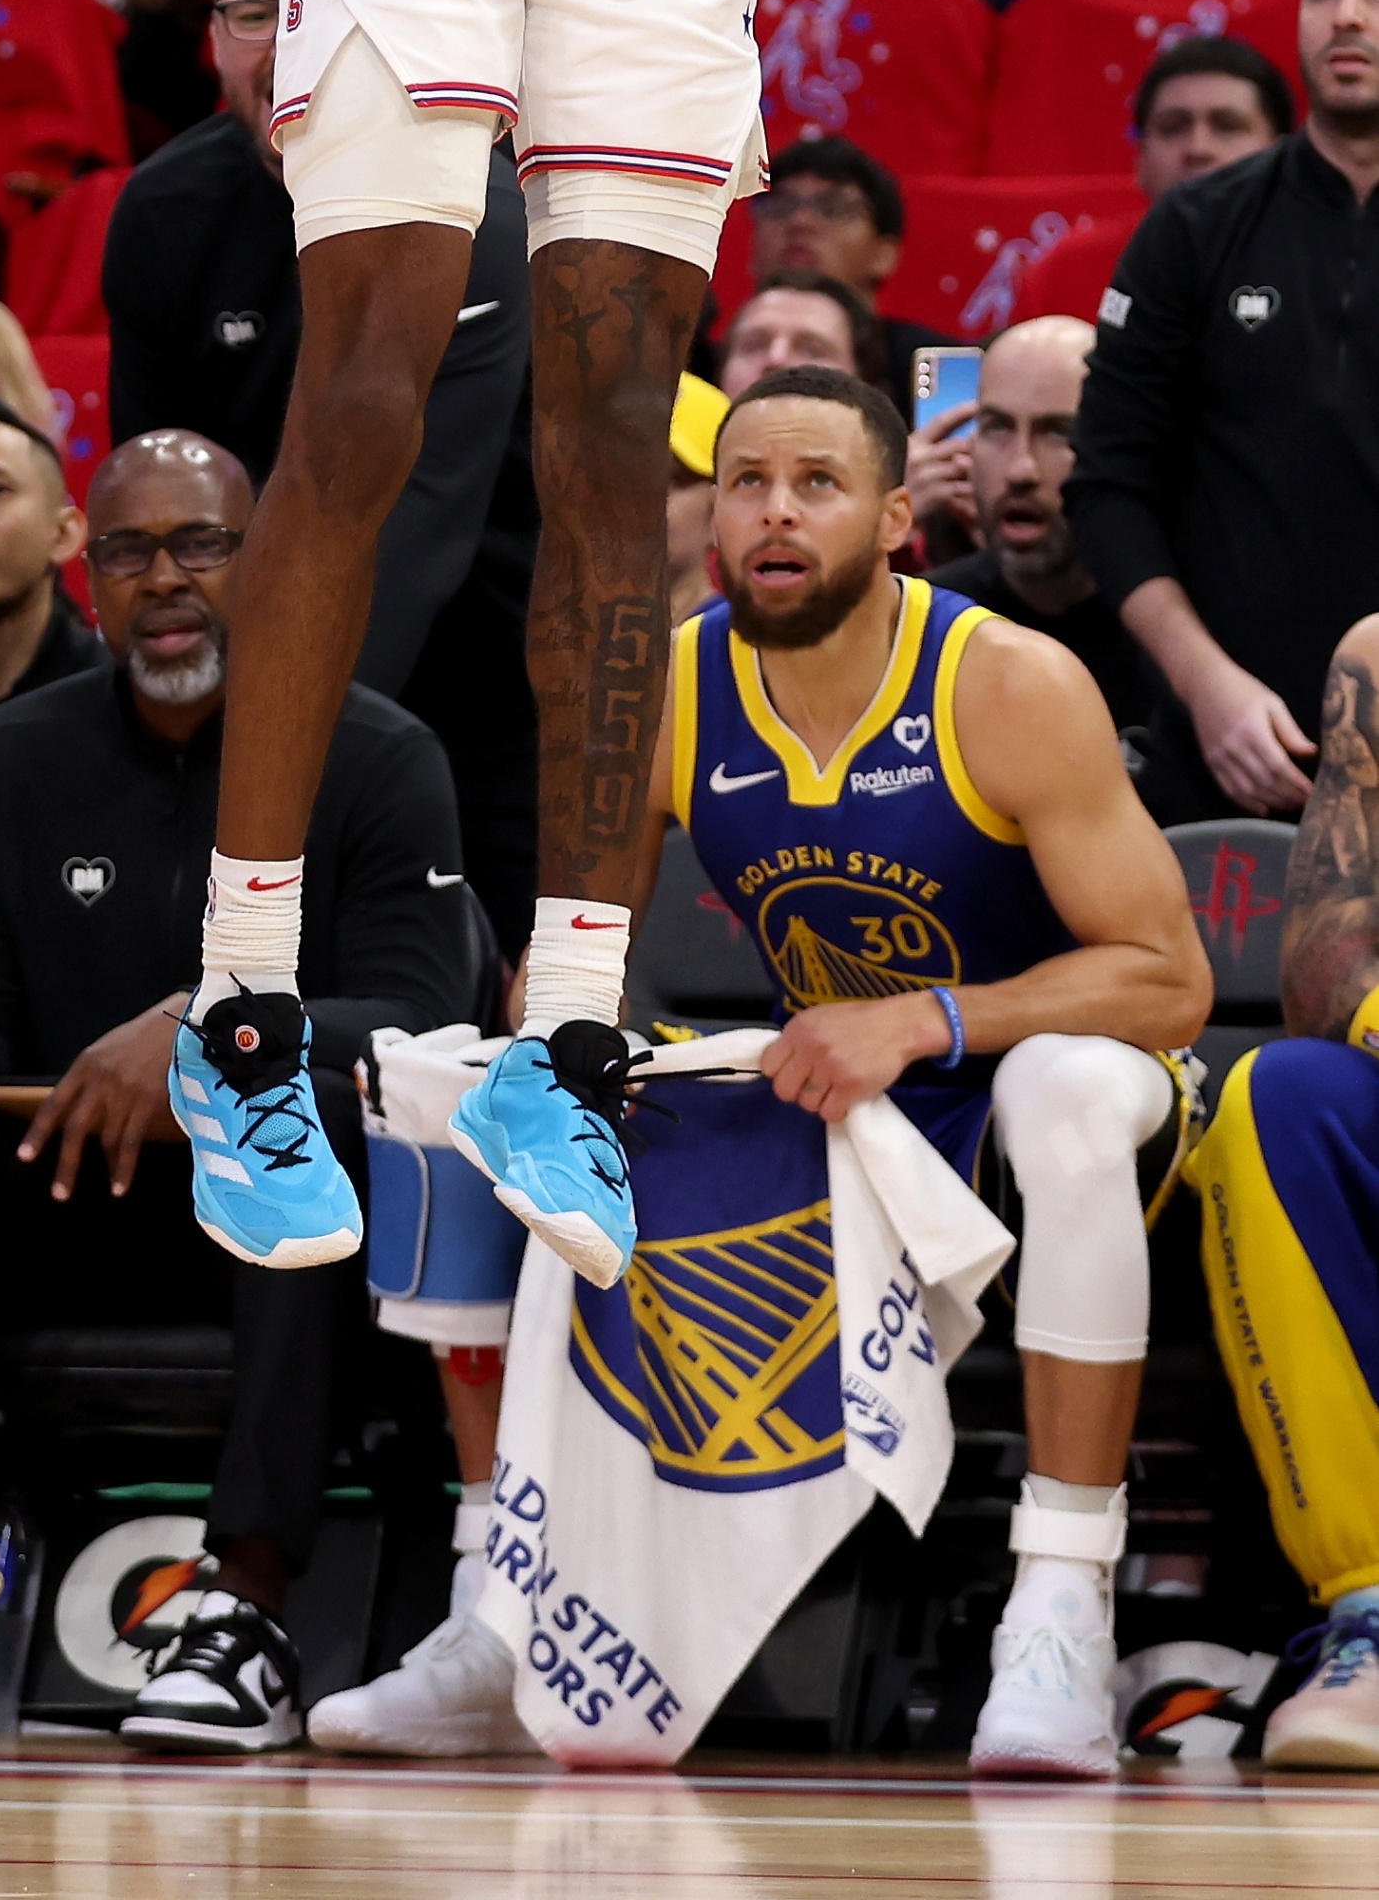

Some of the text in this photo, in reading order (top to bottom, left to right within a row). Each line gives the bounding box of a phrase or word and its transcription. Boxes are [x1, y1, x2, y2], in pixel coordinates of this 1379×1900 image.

[849, 764, 935, 795] Rakuten
[736, 844, 944, 902] GOLDEN STATE
[850, 912, 932, 964] 30
[1234, 1295, 1265, 1368] STATE
[552, 1593, 683, 1734] STATE
